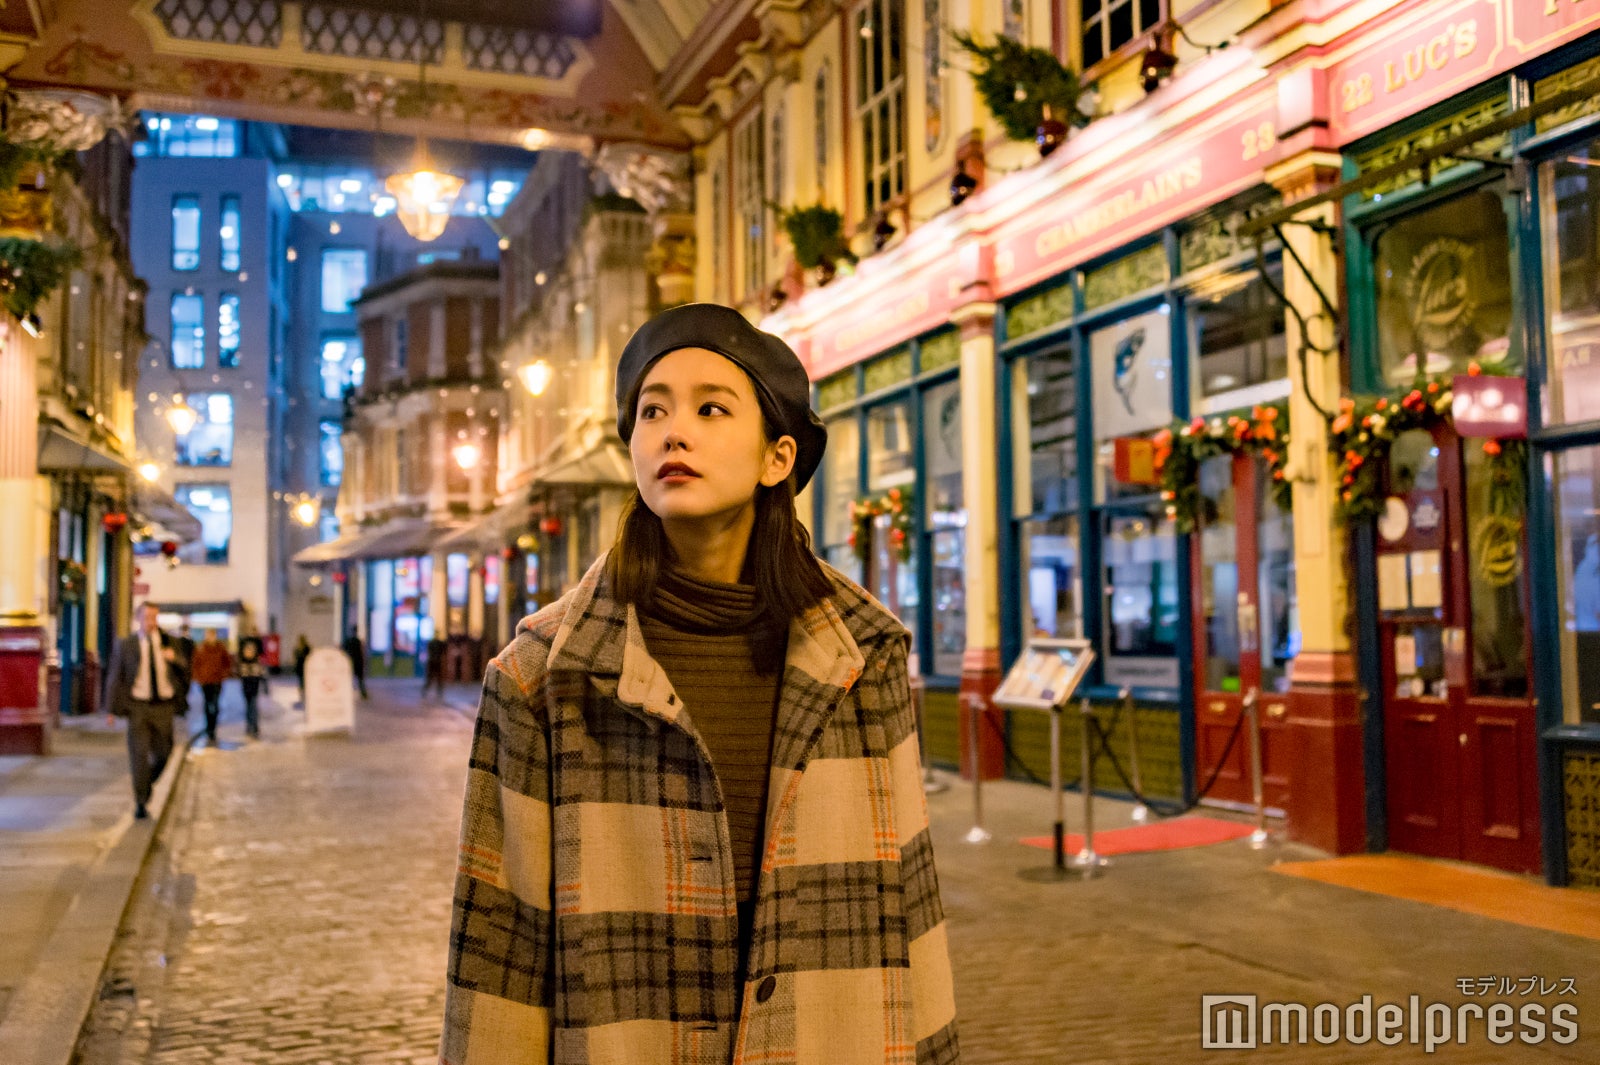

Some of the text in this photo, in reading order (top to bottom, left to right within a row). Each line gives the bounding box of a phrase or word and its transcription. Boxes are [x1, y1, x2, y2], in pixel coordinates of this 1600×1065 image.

[1342, 19, 1477, 112] 22 LUC'S
[1242, 121, 1275, 161] 23
